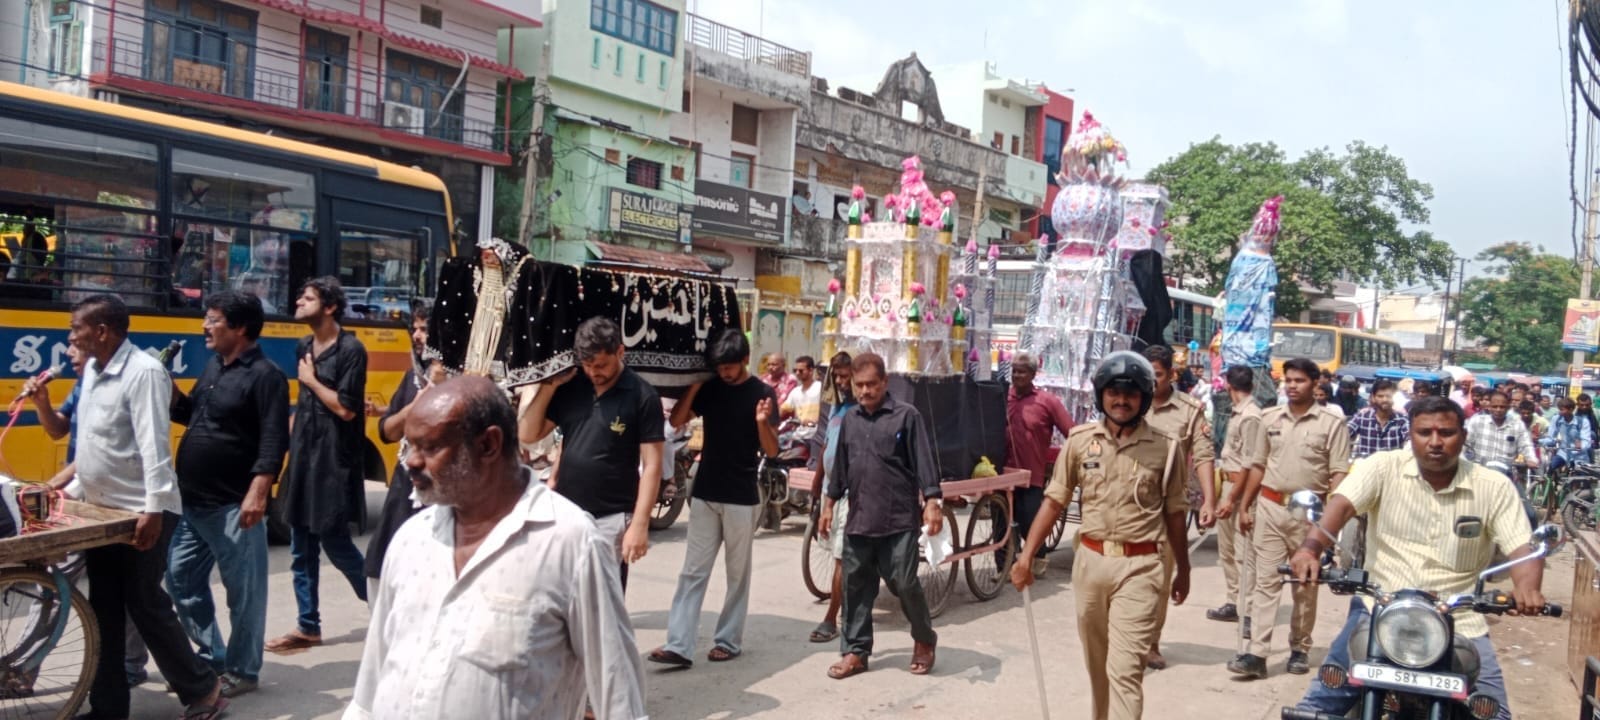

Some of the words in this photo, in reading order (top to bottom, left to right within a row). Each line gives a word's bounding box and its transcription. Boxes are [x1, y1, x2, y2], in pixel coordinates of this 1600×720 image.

[623, 193, 652, 213] SURAJ
[696, 194, 739, 213] nasonic
[623, 209, 677, 230] ELECTRICALS
[9, 334, 188, 374] Scl
[1367, 667, 1383, 679] UP
[1429, 676, 1460, 690] 1282
